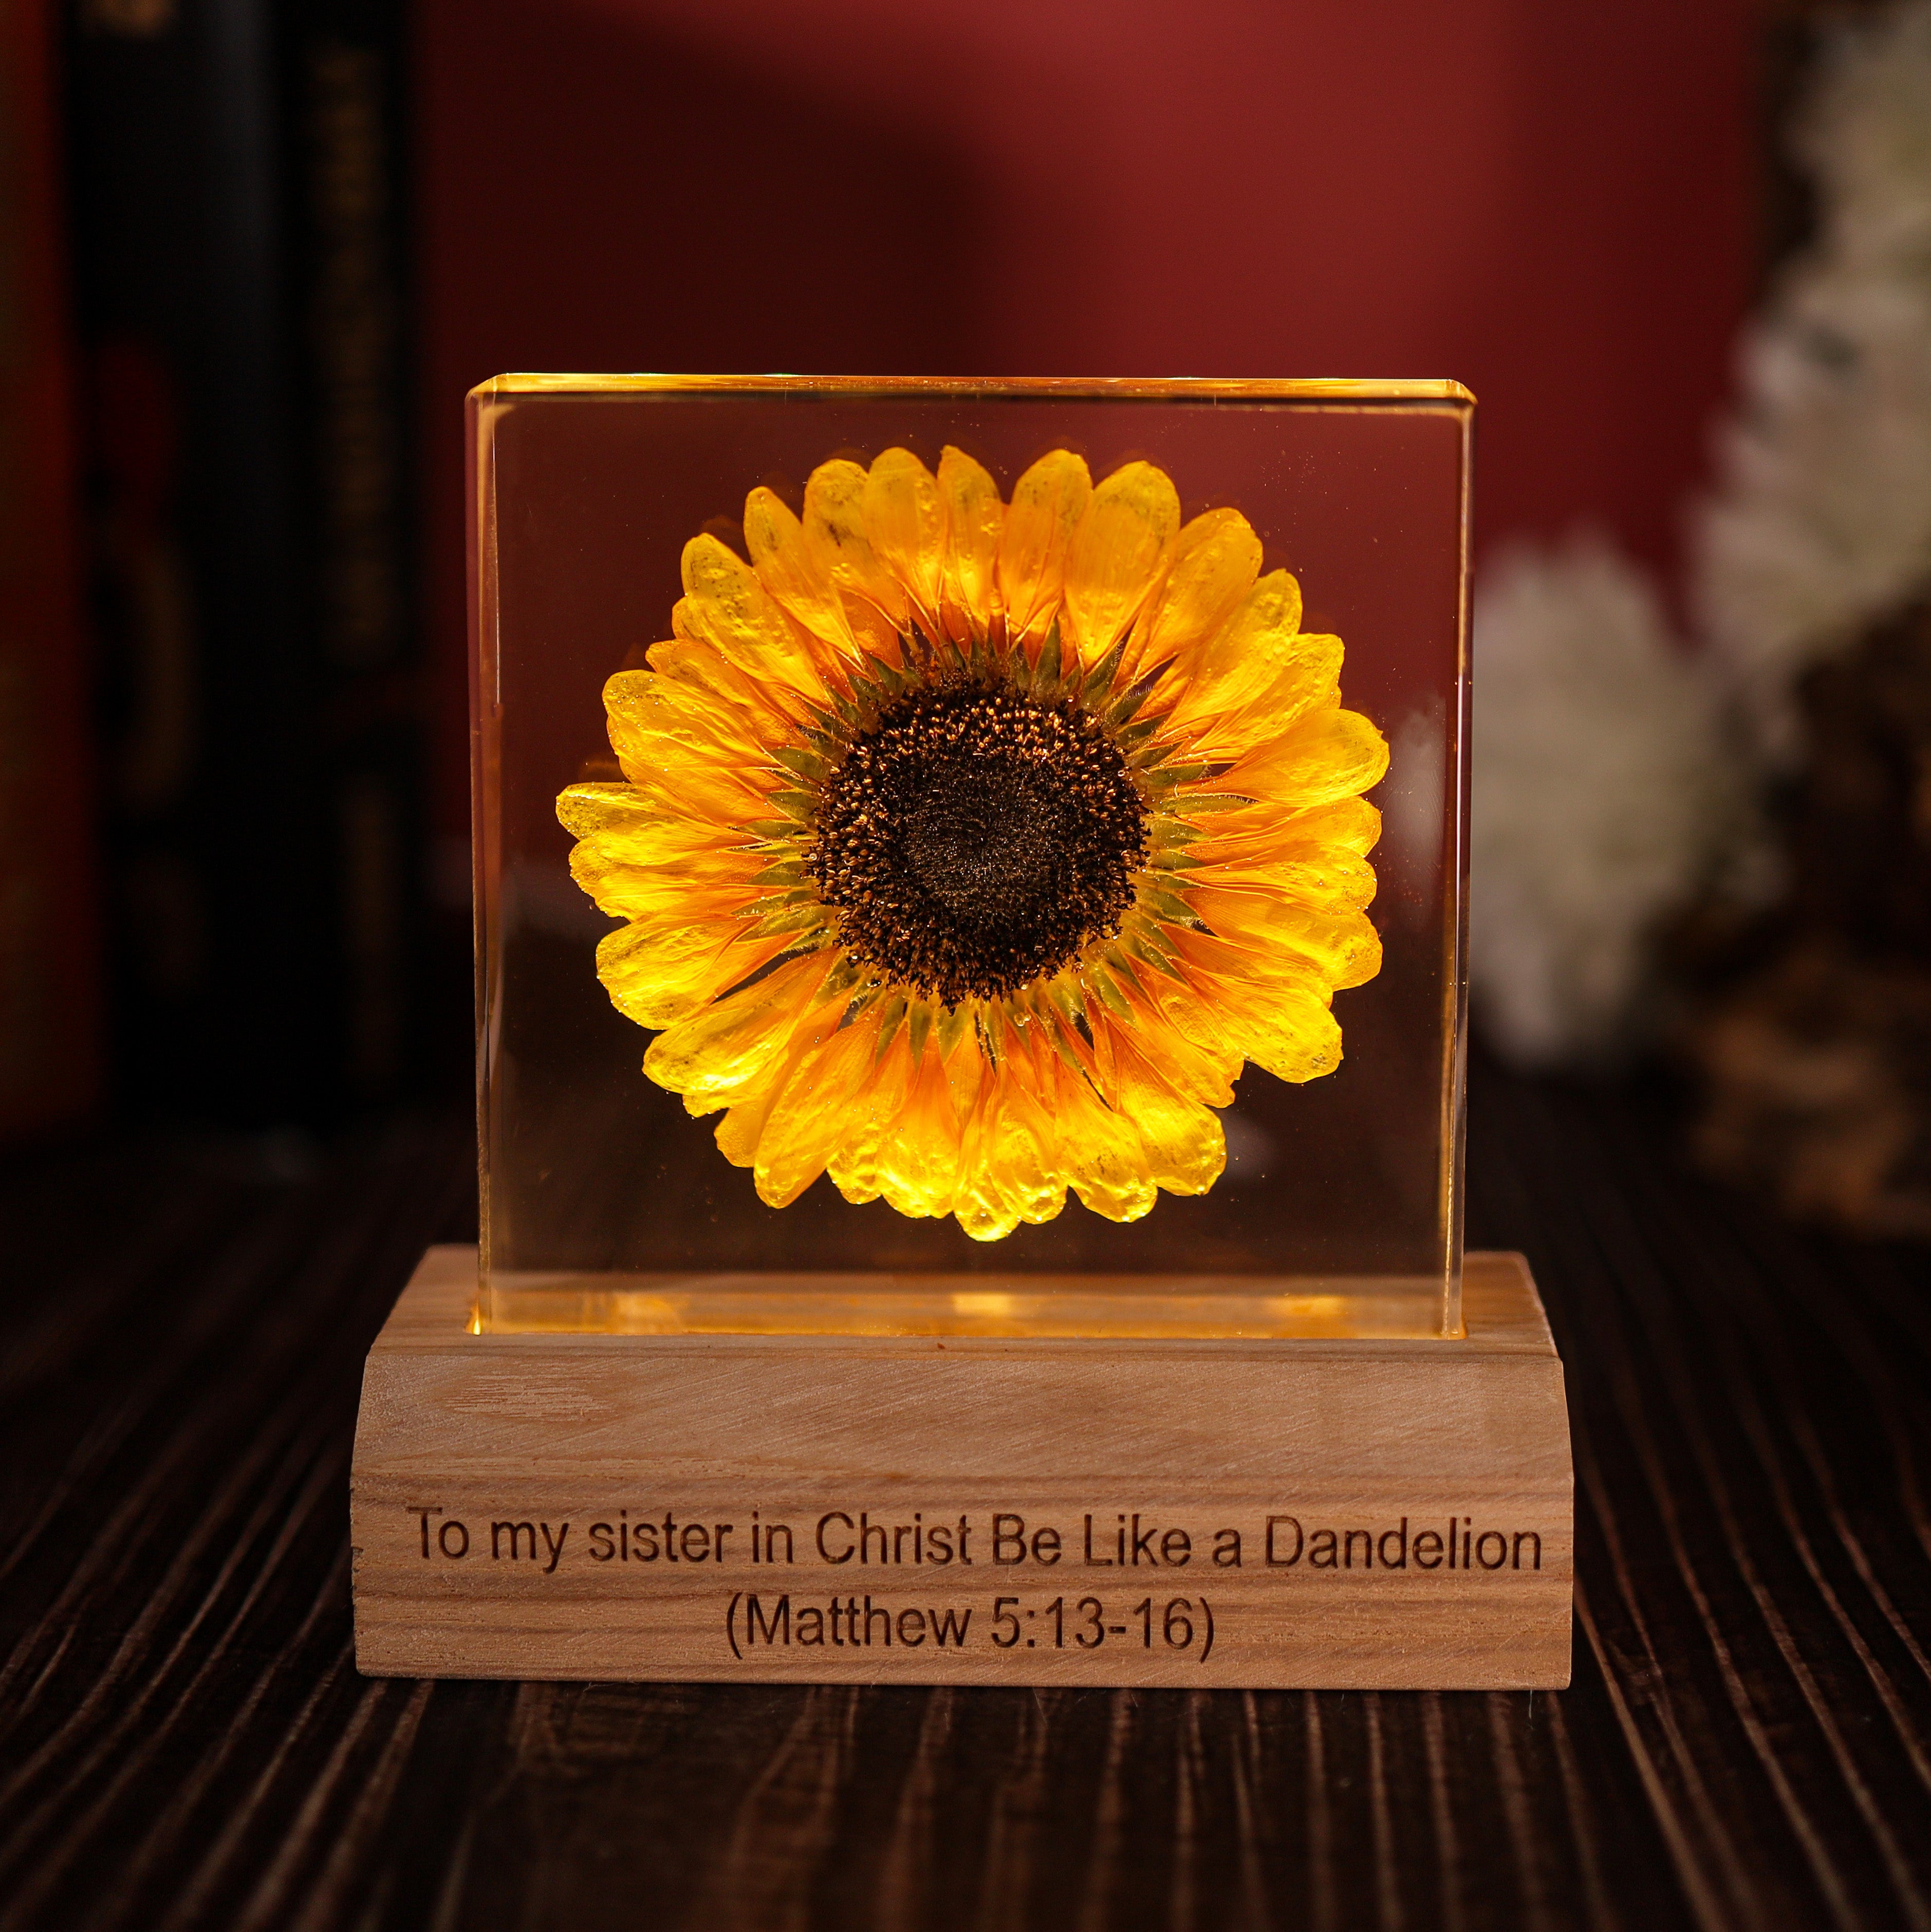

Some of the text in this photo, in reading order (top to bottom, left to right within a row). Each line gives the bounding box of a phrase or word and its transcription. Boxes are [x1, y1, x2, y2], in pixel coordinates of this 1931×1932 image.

[406, 1506, 1542, 1574] To my sister in Christ Be Like a Dandelion
[726, 1591, 1214, 1664] (Matthew 5:13-16)
